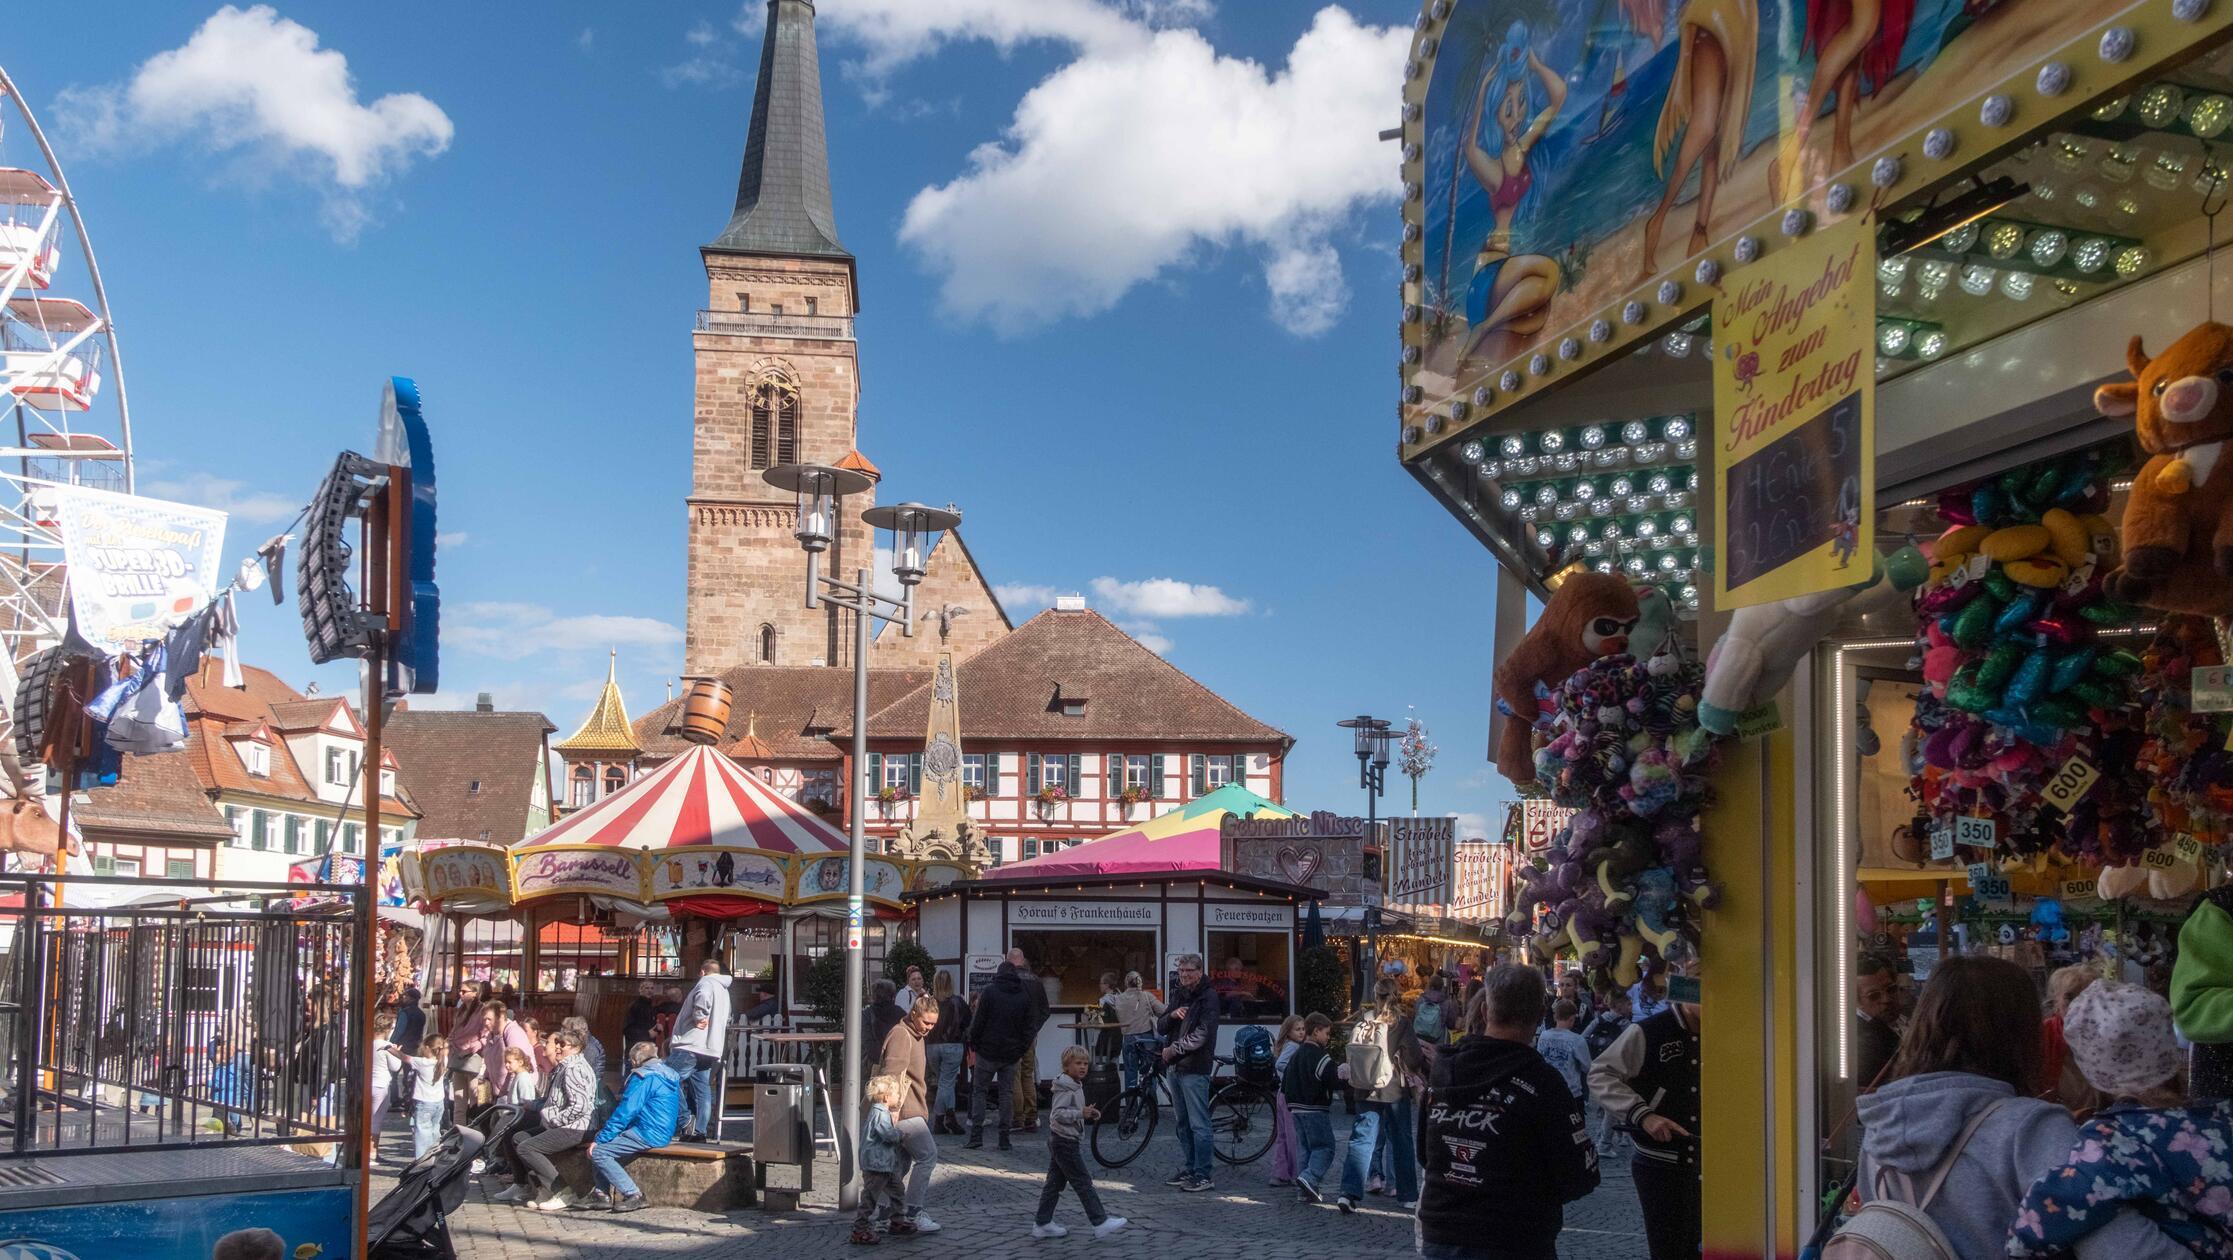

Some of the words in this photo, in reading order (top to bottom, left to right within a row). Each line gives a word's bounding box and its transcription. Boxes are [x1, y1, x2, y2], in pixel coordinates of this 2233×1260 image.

[1752, 241, 1861, 347] Angebot
[1722, 279, 1775, 329] Mein
[1776, 323, 1828, 376] zum
[1725, 347, 1863, 453] Kindertag
[92, 547, 154, 572] SUPER
[106, 573, 166, 597] BRILLE
[1741, 720, 1779, 738] Punkte
[2051, 762, 2088, 800] 600
[1527, 806, 1574, 818] Ströbels
[1221, 811, 1310, 836] Gebrannte
[1311, 810, 1363, 836] Nüsse
[1961, 822, 1993, 841] 350
[1393, 826, 1453, 841] Ströbels
[1529, 819, 1568, 848] Ei
[1932, 832, 1949, 852] 350
[1408, 844, 1432, 861] frisch
[2177, 835, 2198, 855] 450
[1400, 855, 1444, 875] gebrannte
[1454, 851, 1502, 863] Ströbels
[2146, 851, 2175, 867] 600
[1393, 869, 1450, 893] Mandeln
[1464, 866, 1485, 879] frisch
[1457, 876, 1495, 890] gebrannte
[1979, 879, 2010, 896] 350
[2066, 879, 2095, 894] 600
[1454, 889, 1499, 908] Mandeln
[1215, 908, 1283, 923] Feuerspatzen
